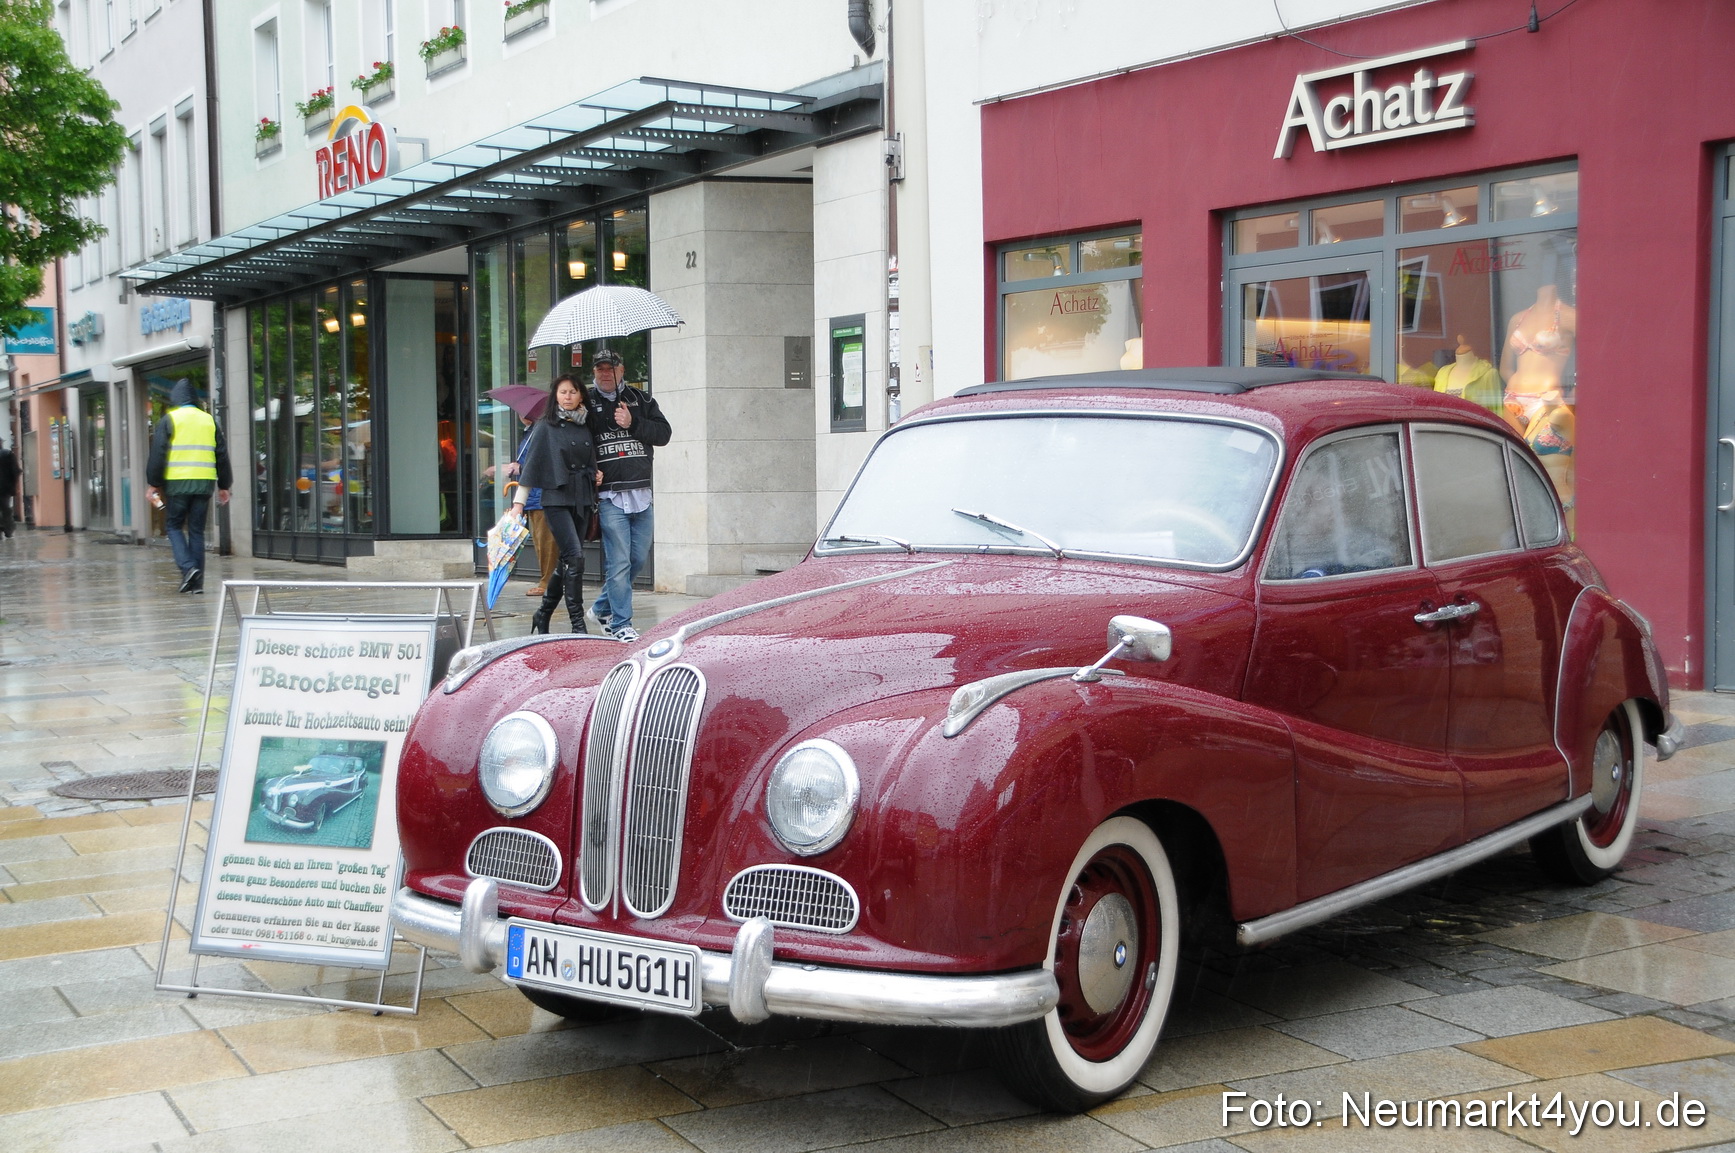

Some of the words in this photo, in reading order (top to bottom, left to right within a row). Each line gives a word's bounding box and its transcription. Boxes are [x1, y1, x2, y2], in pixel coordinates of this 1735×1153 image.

[1273, 68, 1474, 160] Achatz
[316, 122, 389, 201] RENO
[685, 250, 697, 269] 22
[1050, 291, 1099, 315] Achatz
[1272, 336, 1334, 363] Achatz
[599, 442, 644, 456] SIEMENS
[255, 638, 300, 656] Dieser
[304, 642, 355, 659] schöne
[358, 641, 393, 659] BMW
[397, 643, 422, 660] 501
[251, 666, 411, 699] "Barockengel"
[244, 708, 283, 726] könnte
[285, 709, 302, 729] Ihr
[304, 711, 381, 731] Hochzeitsauto
[222, 854, 256, 867] gönnen
[258, 855, 271, 867] Sie
[273, 858, 291, 869] sich
[293, 861, 304, 870] an
[307, 859, 333, 870] Ihrem
[220, 872, 245, 883] etwas
[246, 875, 267, 887] ganz
[269, 876, 318, 889] Besonderes
[321, 879, 338, 890] und
[339, 880, 370, 894] buchen
[372, 883, 386, 895] Sie
[216, 890, 242, 901] dieses
[244, 894, 303, 907] wunderschöne
[304, 897, 324, 907] Auto
[326, 899, 341, 909] mit
[343, 899, 384, 912] Chauffeur
[211, 925, 229, 934] oder
[231, 927, 254, 937] unter
[213, 910, 261, 923] Genaueres
[263, 915, 302, 926] erfahren
[305, 917, 319, 927] Sie
[322, 920, 334, 929] an
[336, 920, 352, 931] der
[353, 921, 380, 932] Kasse
[513, 956, 520, 968] D
[526, 936, 558, 977] AN
